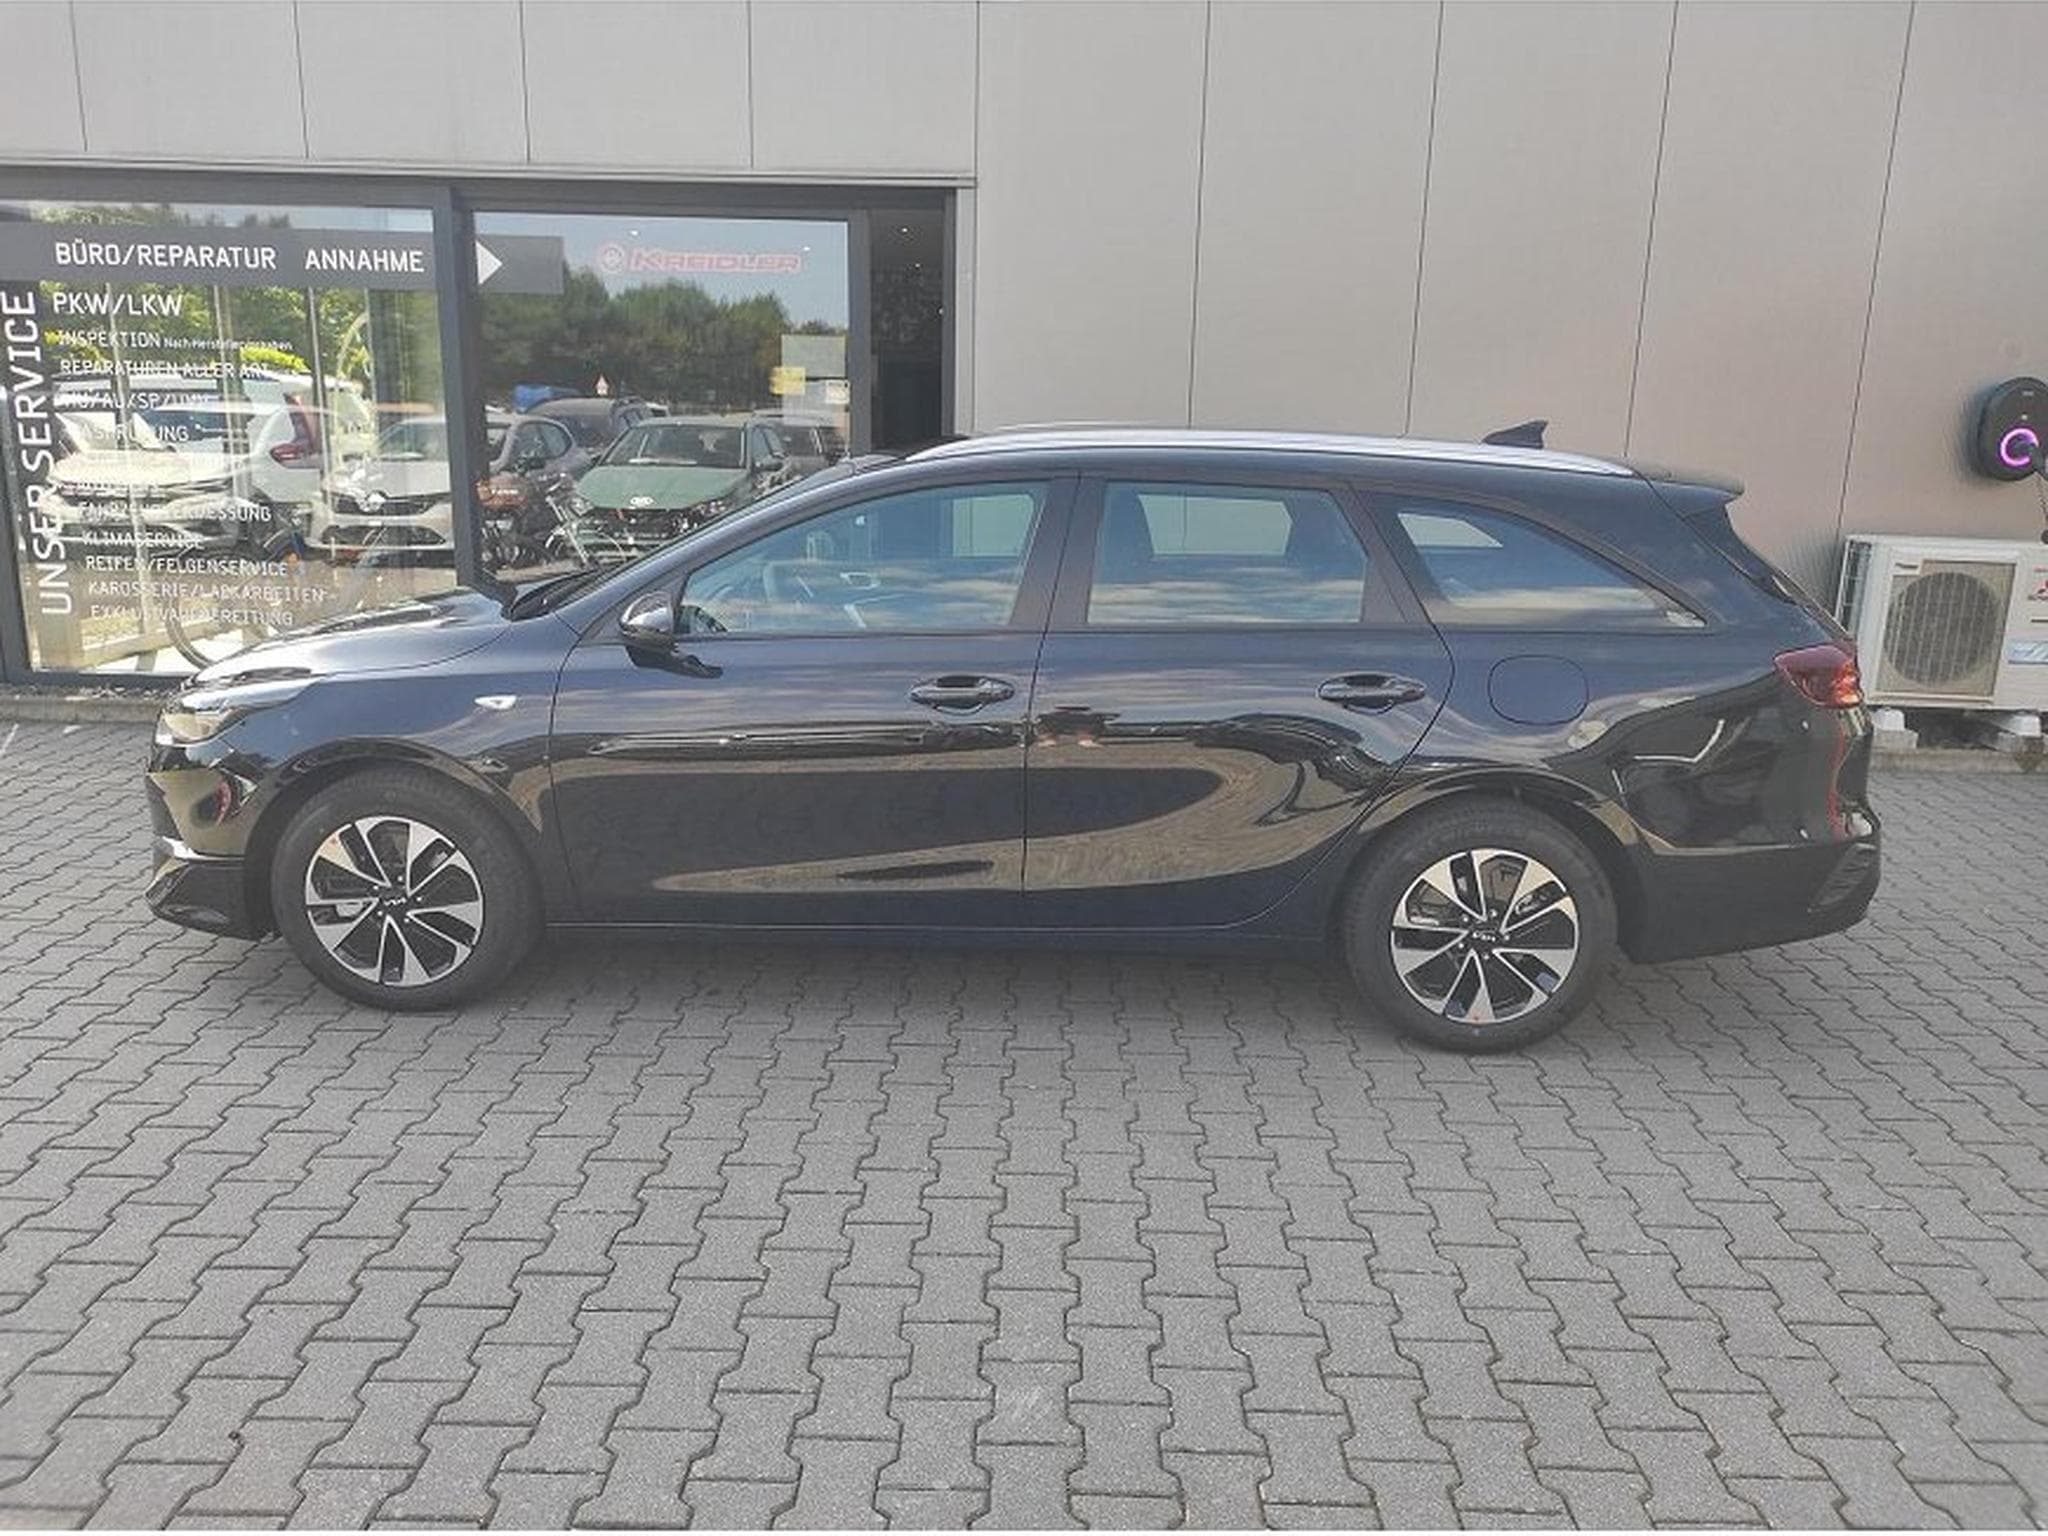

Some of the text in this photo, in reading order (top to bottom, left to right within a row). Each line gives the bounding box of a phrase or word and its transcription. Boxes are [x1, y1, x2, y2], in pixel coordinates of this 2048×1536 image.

[55, 238, 425, 273] BÜRO/REPARATUR ANNAHME
[52, 291, 183, 316] PKW/LKW
[58, 329, 161, 348] INSPEKTION
[1, 290, 72, 616] UNSER SERVICE
[86, 555, 288, 577] REIFEN/FELGENSERVICE
